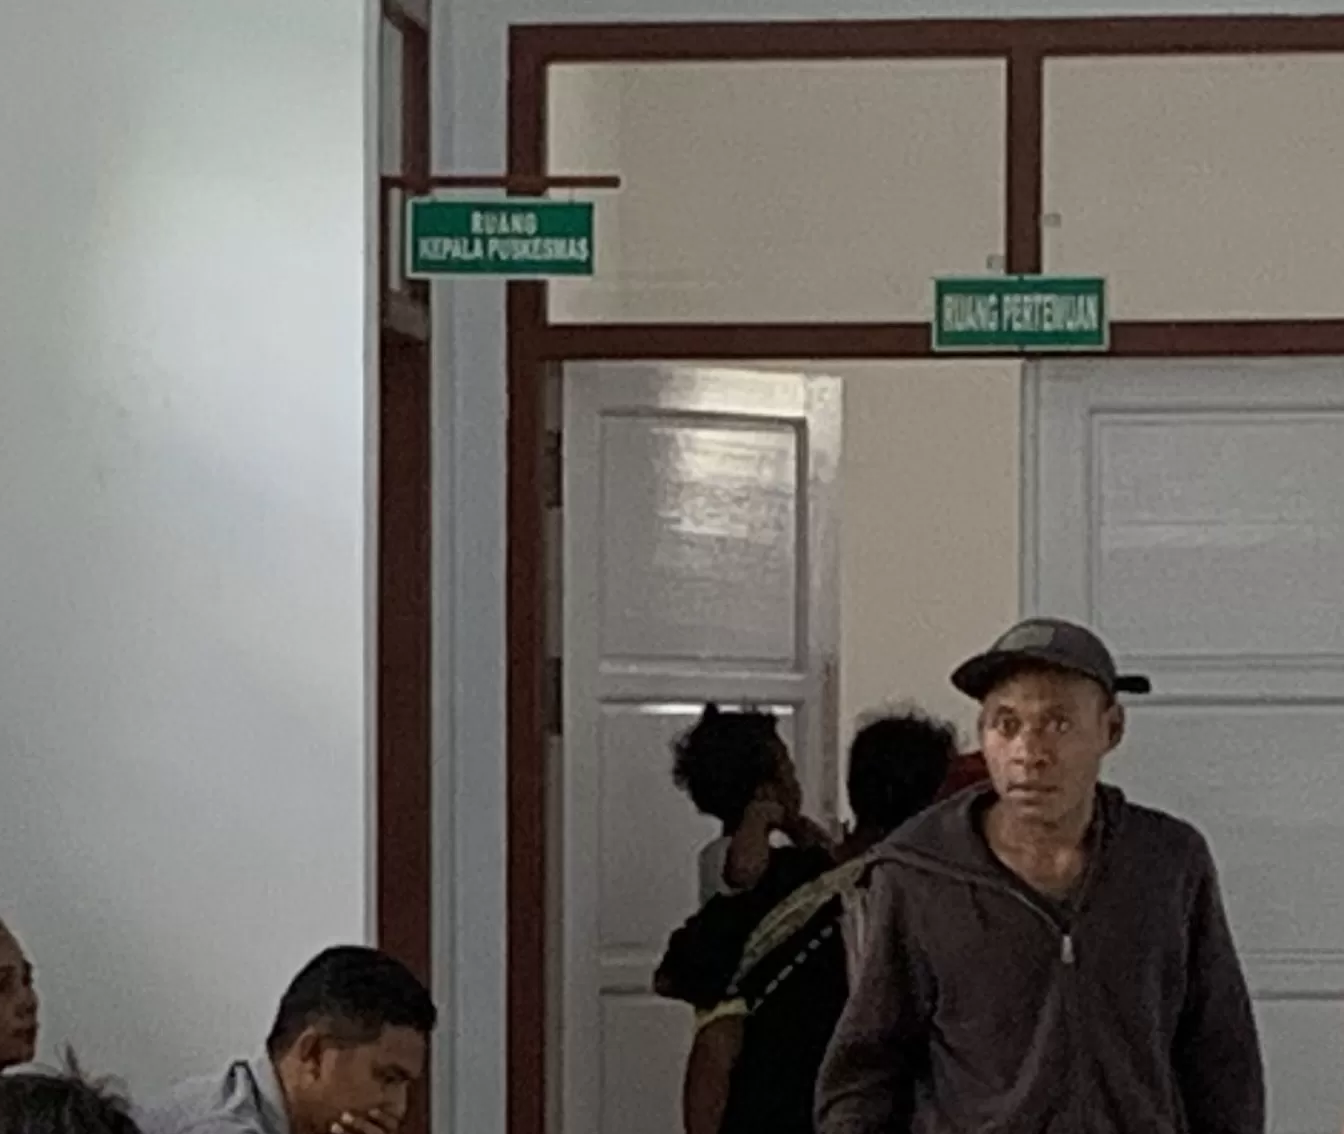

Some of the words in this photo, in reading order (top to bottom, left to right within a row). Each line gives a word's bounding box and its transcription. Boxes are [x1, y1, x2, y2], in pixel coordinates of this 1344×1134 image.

[470, 210, 539, 236] RUANG
[418, 236, 484, 261] KEPALA
[486, 236, 590, 263] PUSKESMAS
[942, 292, 1000, 333] RUANG
[1001, 292, 1100, 333] PERTEMUAN
